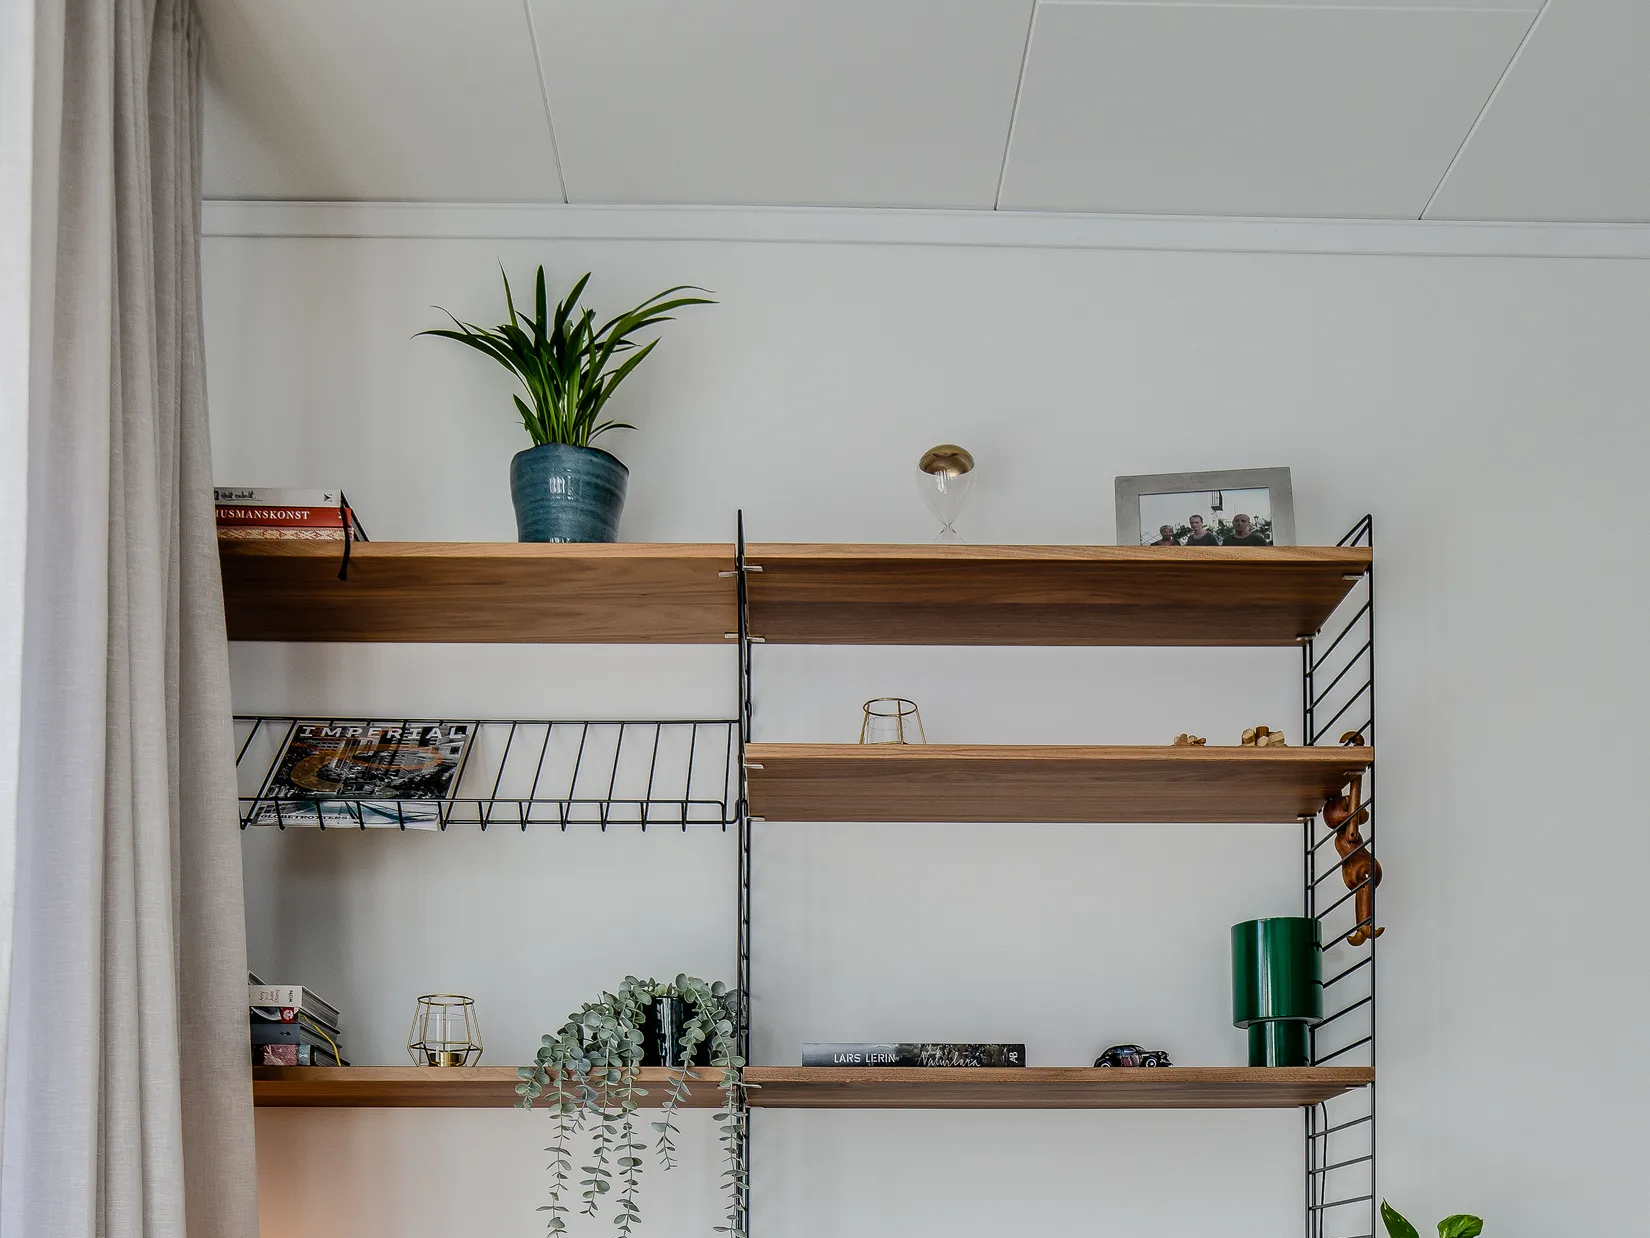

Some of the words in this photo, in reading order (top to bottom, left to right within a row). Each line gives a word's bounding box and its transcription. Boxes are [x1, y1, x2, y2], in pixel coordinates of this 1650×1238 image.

[300, 726, 465, 740] IMPERIAL
[834, 1053, 861, 1063] LARS
[865, 1053, 896, 1063] LERIN
